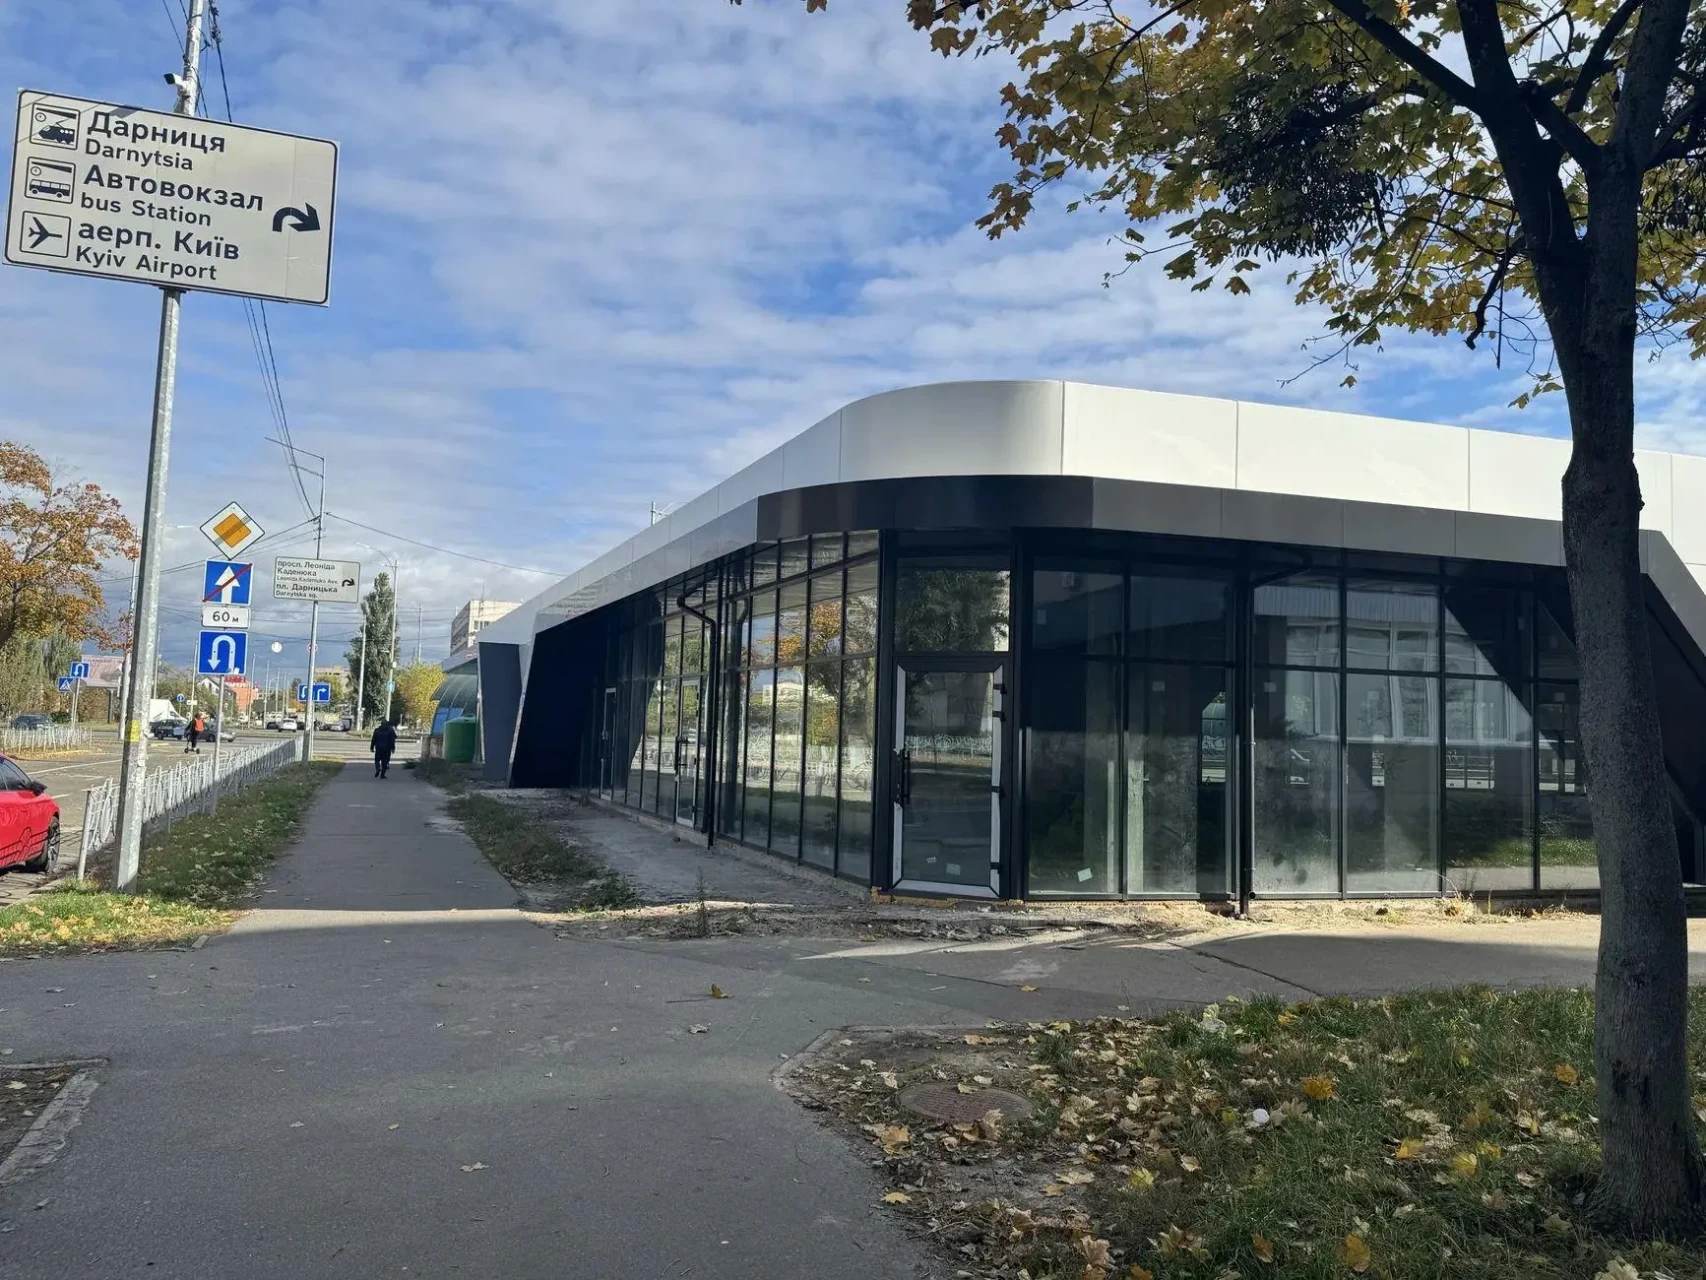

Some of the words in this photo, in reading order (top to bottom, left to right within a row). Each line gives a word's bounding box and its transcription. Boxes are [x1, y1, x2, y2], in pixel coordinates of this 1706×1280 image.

[86, 111, 225, 154] Дарниця
[85, 138, 193, 171] Darnytsia
[83, 164, 263, 212] Автовокзал
[80, 192, 121, 213] bus
[131, 200, 211, 227] Station
[78, 222, 162, 249] аерп.
[174, 230, 239, 260] Київ
[75, 246, 126, 268] Kyiv
[135, 255, 217, 281] Airport
[277, 567, 317, 577] Каденюка
[304, 561, 336, 571] Леоніда
[291, 583, 338, 593] Дарницька
[212, 610, 230, 622] 60
